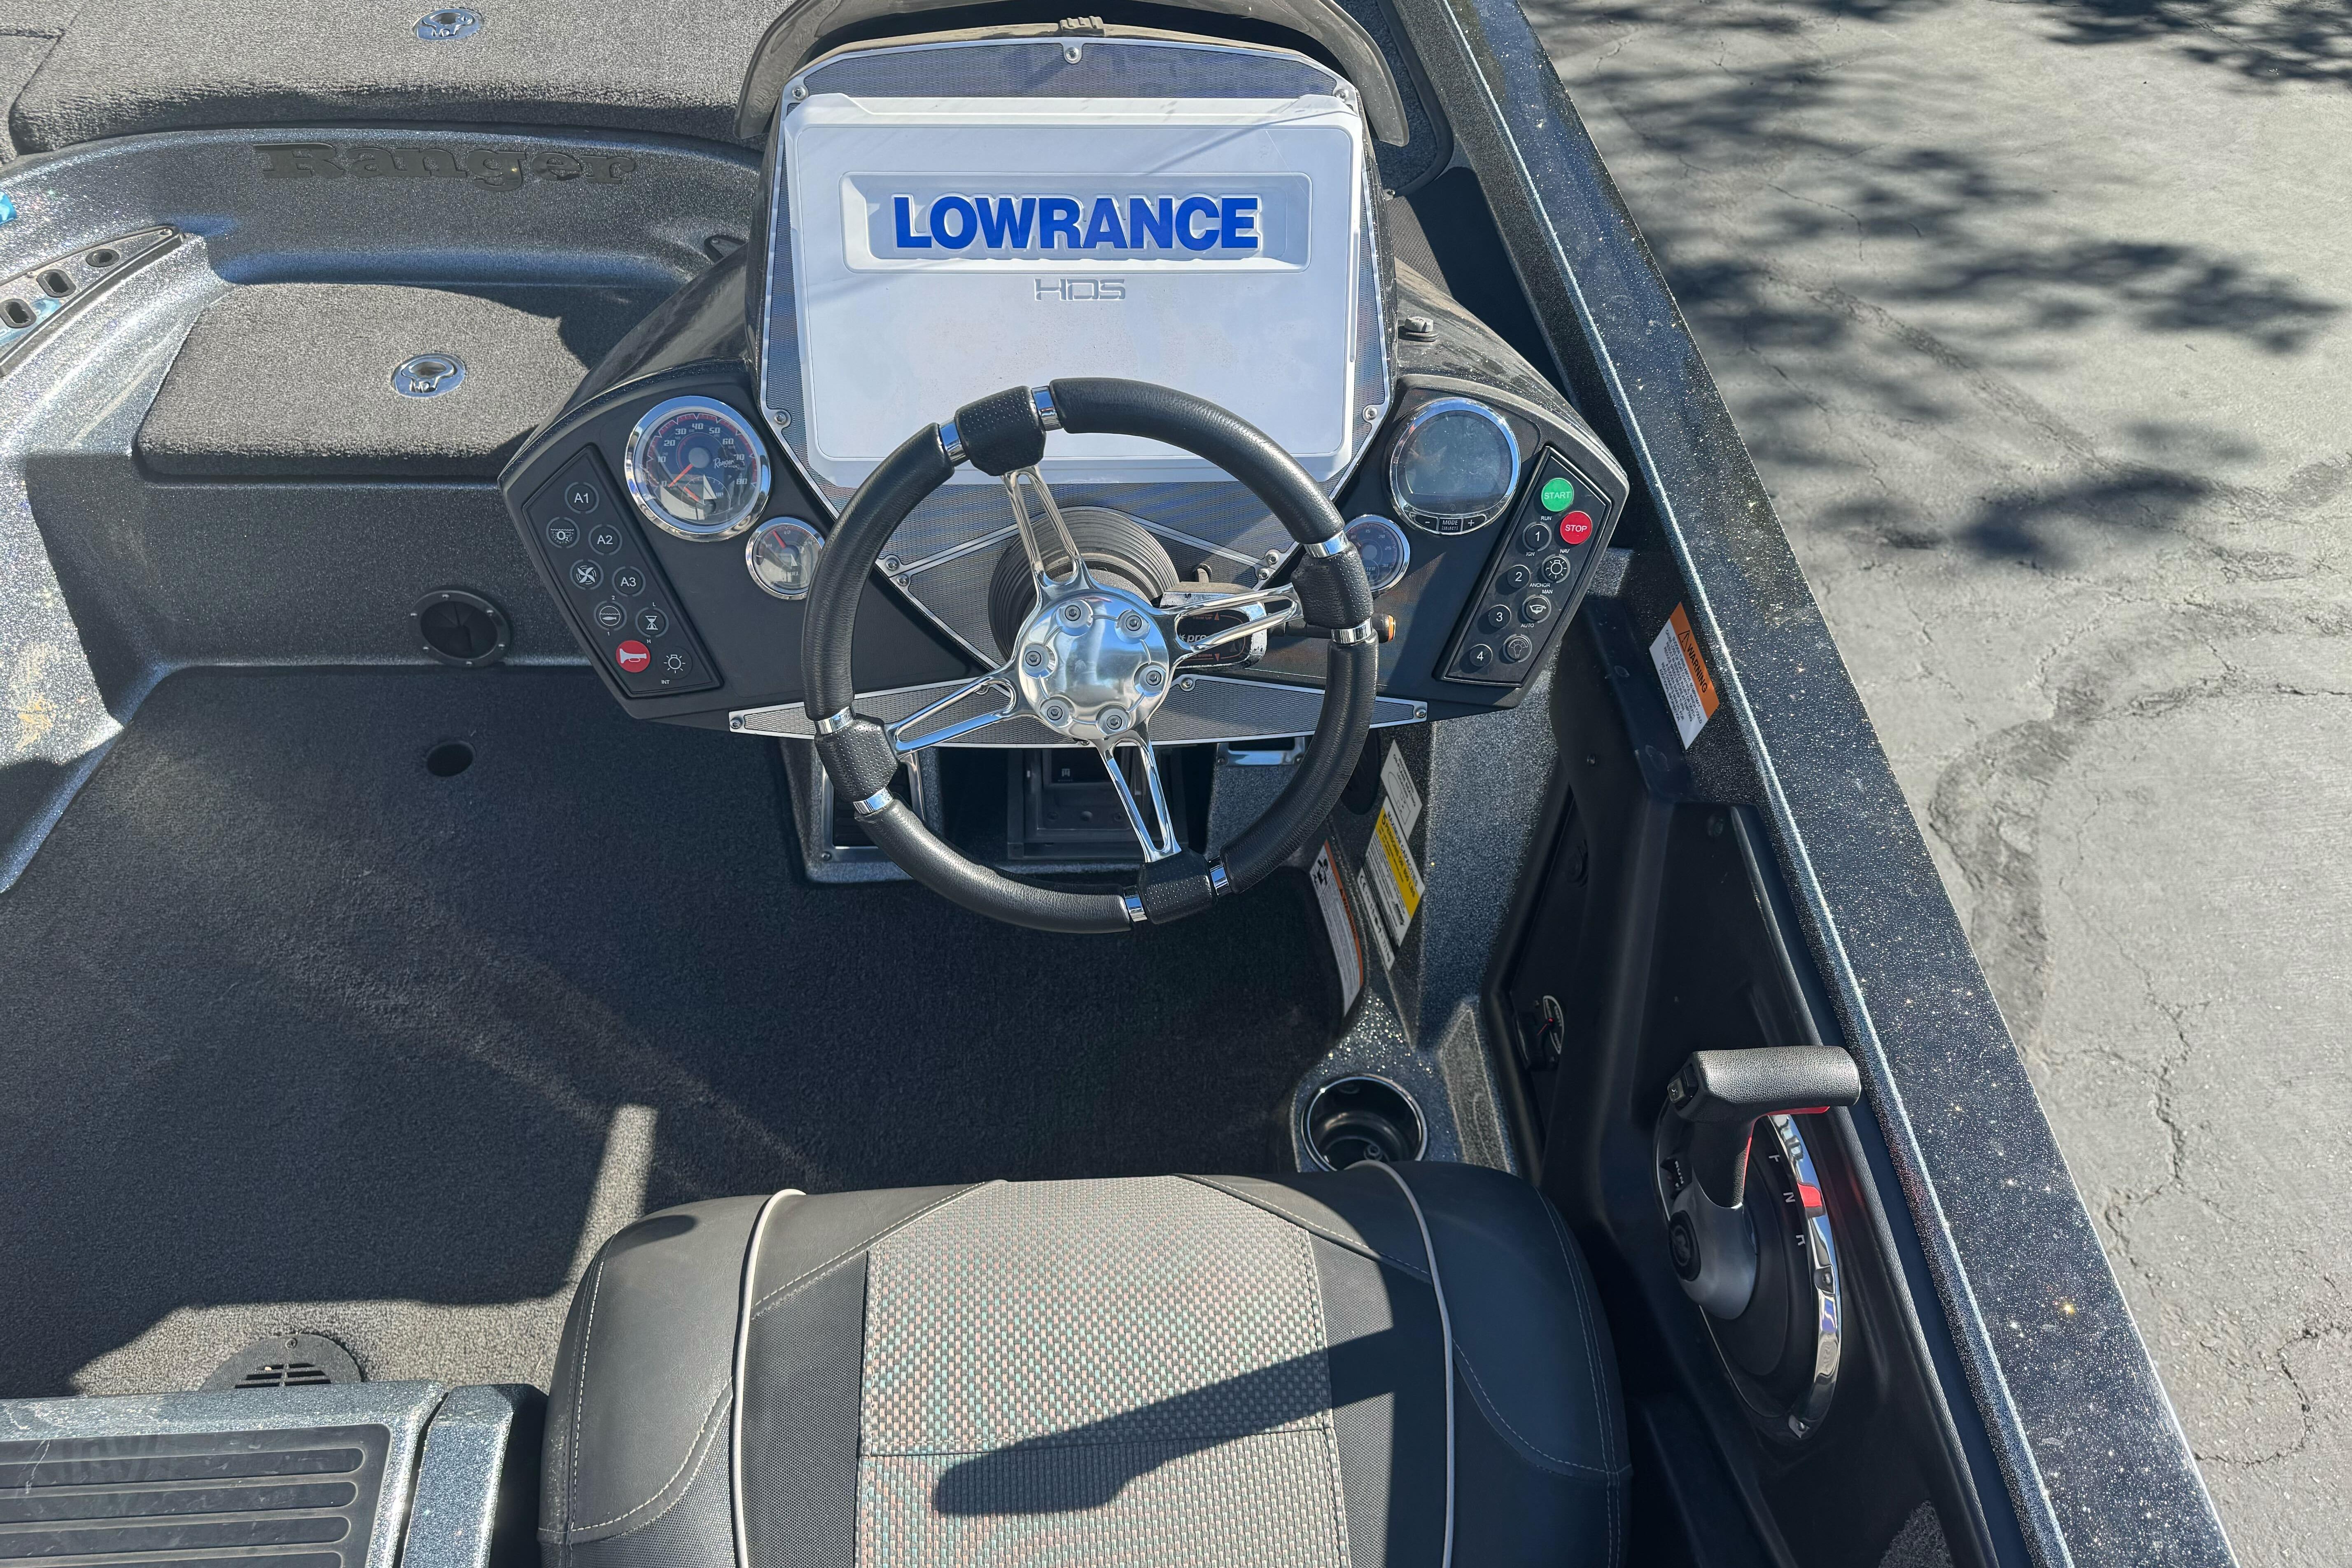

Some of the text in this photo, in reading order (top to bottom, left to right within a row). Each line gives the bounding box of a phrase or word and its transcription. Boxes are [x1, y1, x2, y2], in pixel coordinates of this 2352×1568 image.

[253, 143, 635, 192] Ranger
[894, 194, 1259, 249] LOWRANCE
[1035, 278, 1125, 301] HDS
[713, 458, 734, 469] Ranger
[574, 493, 589, 503] A1
[597, 535, 613, 545] A2
[1535, 532, 1540, 541] 1
[1515, 572, 1522, 581] 2
[621, 577, 636, 587] A3
[1496, 612, 1503, 622] 3
[1477, 651, 1484, 661] 4
[1687, 643, 1708, 693] WARNING
[1384, 821, 1399, 857] PERSONS
[1783, 1192, 1795, 1202] N
